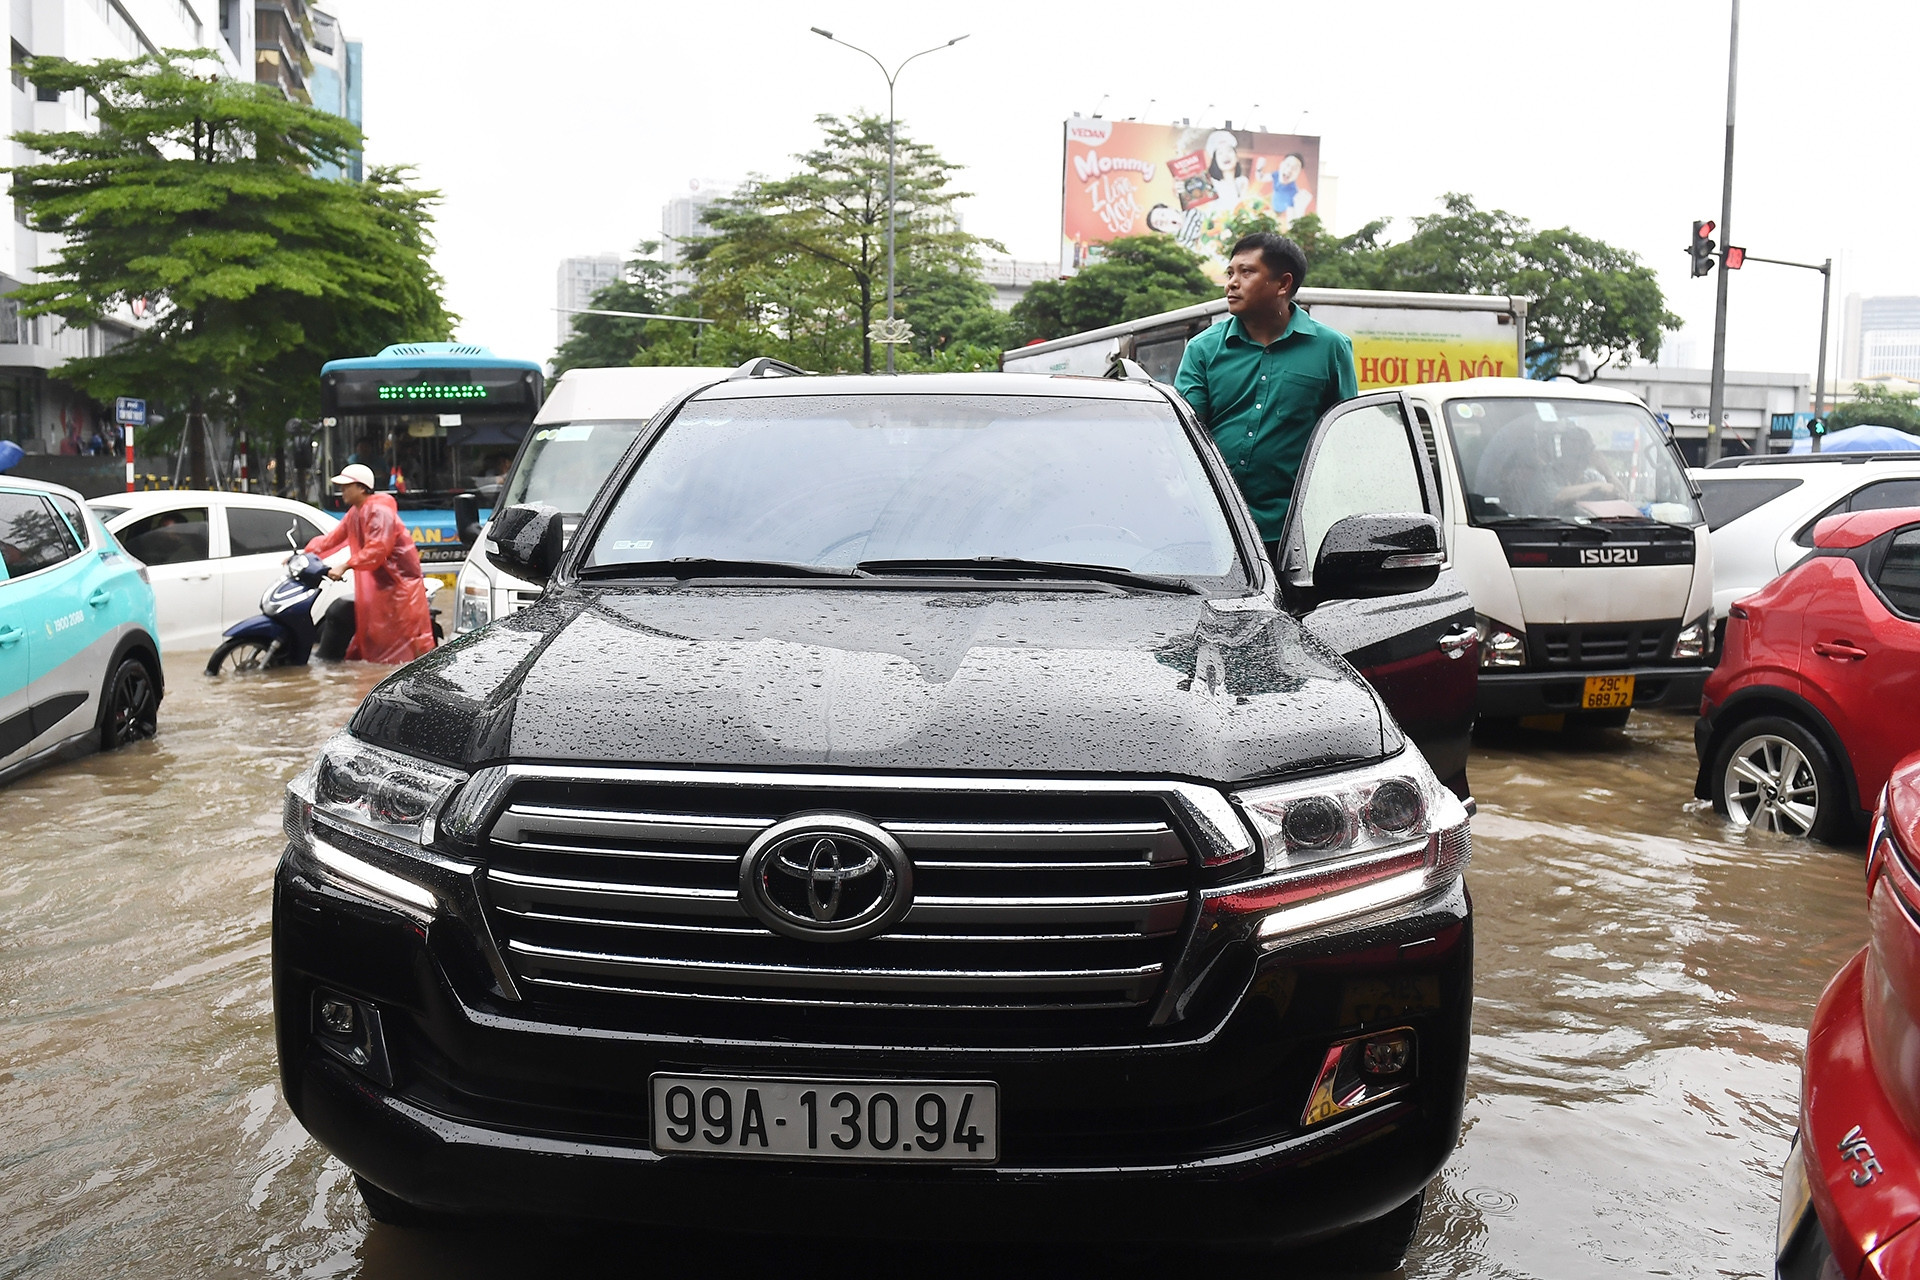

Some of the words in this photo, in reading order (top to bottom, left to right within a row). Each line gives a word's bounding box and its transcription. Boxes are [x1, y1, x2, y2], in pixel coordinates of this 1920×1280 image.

[1072, 127, 1105, 139] VEDAN
[1073, 149, 1156, 182] Mommy
[1360, 356, 1408, 384] HƠI
[1416, 352, 1452, 384] HÀ
[1580, 549, 1639, 564] ISUZU
[1599, 678, 1621, 691] 29C
[664, 1084, 986, 1152] 99A-130.94
